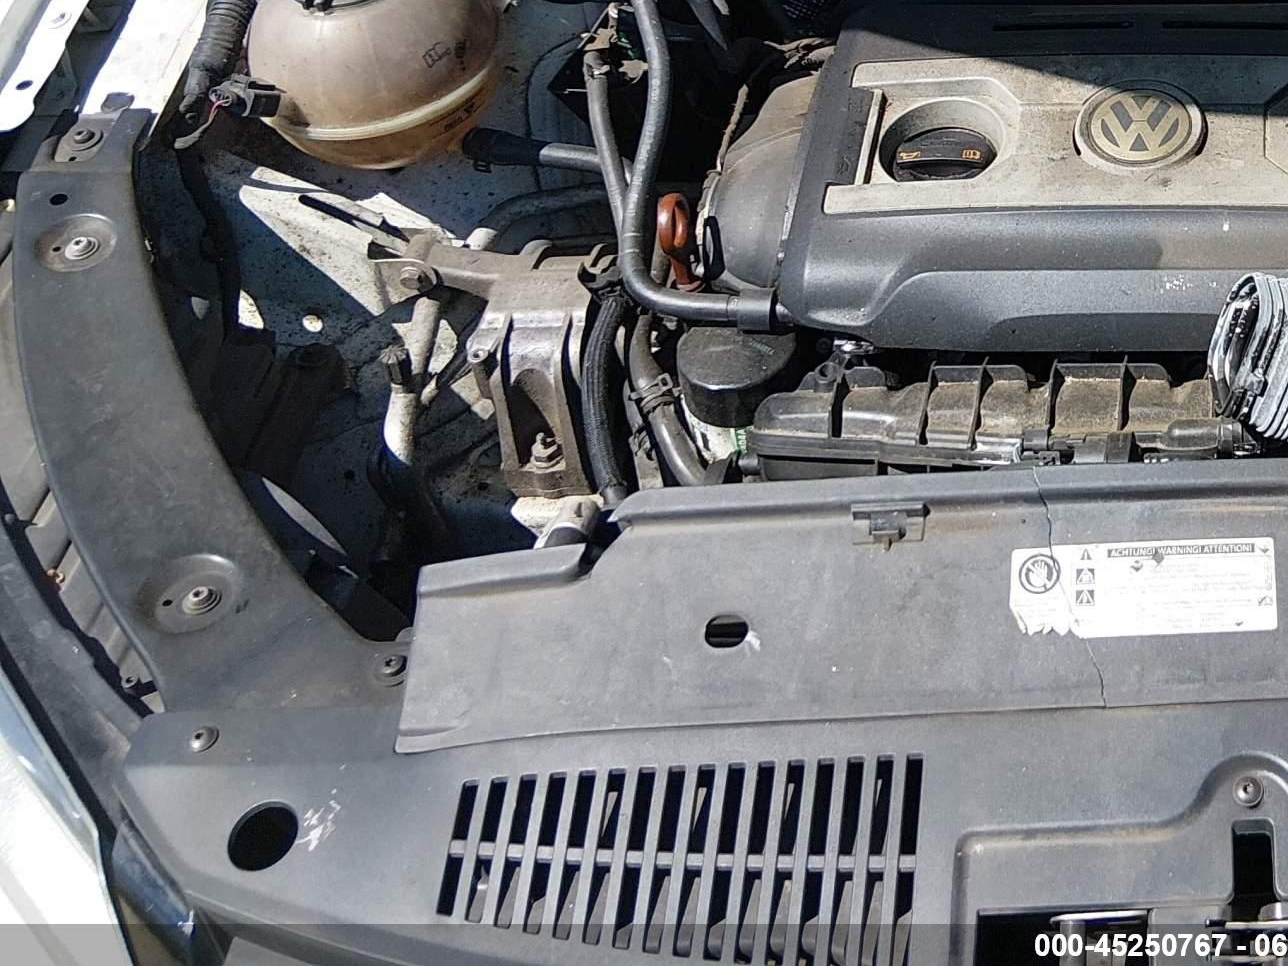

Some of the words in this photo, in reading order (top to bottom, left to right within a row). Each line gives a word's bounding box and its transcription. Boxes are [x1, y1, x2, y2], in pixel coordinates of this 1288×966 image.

[1110, 546, 1156, 558] ACHTUNG!
[1157, 545, 1203, 556] WARNING!
[1204, 543, 1252, 555] ATTENTION!
